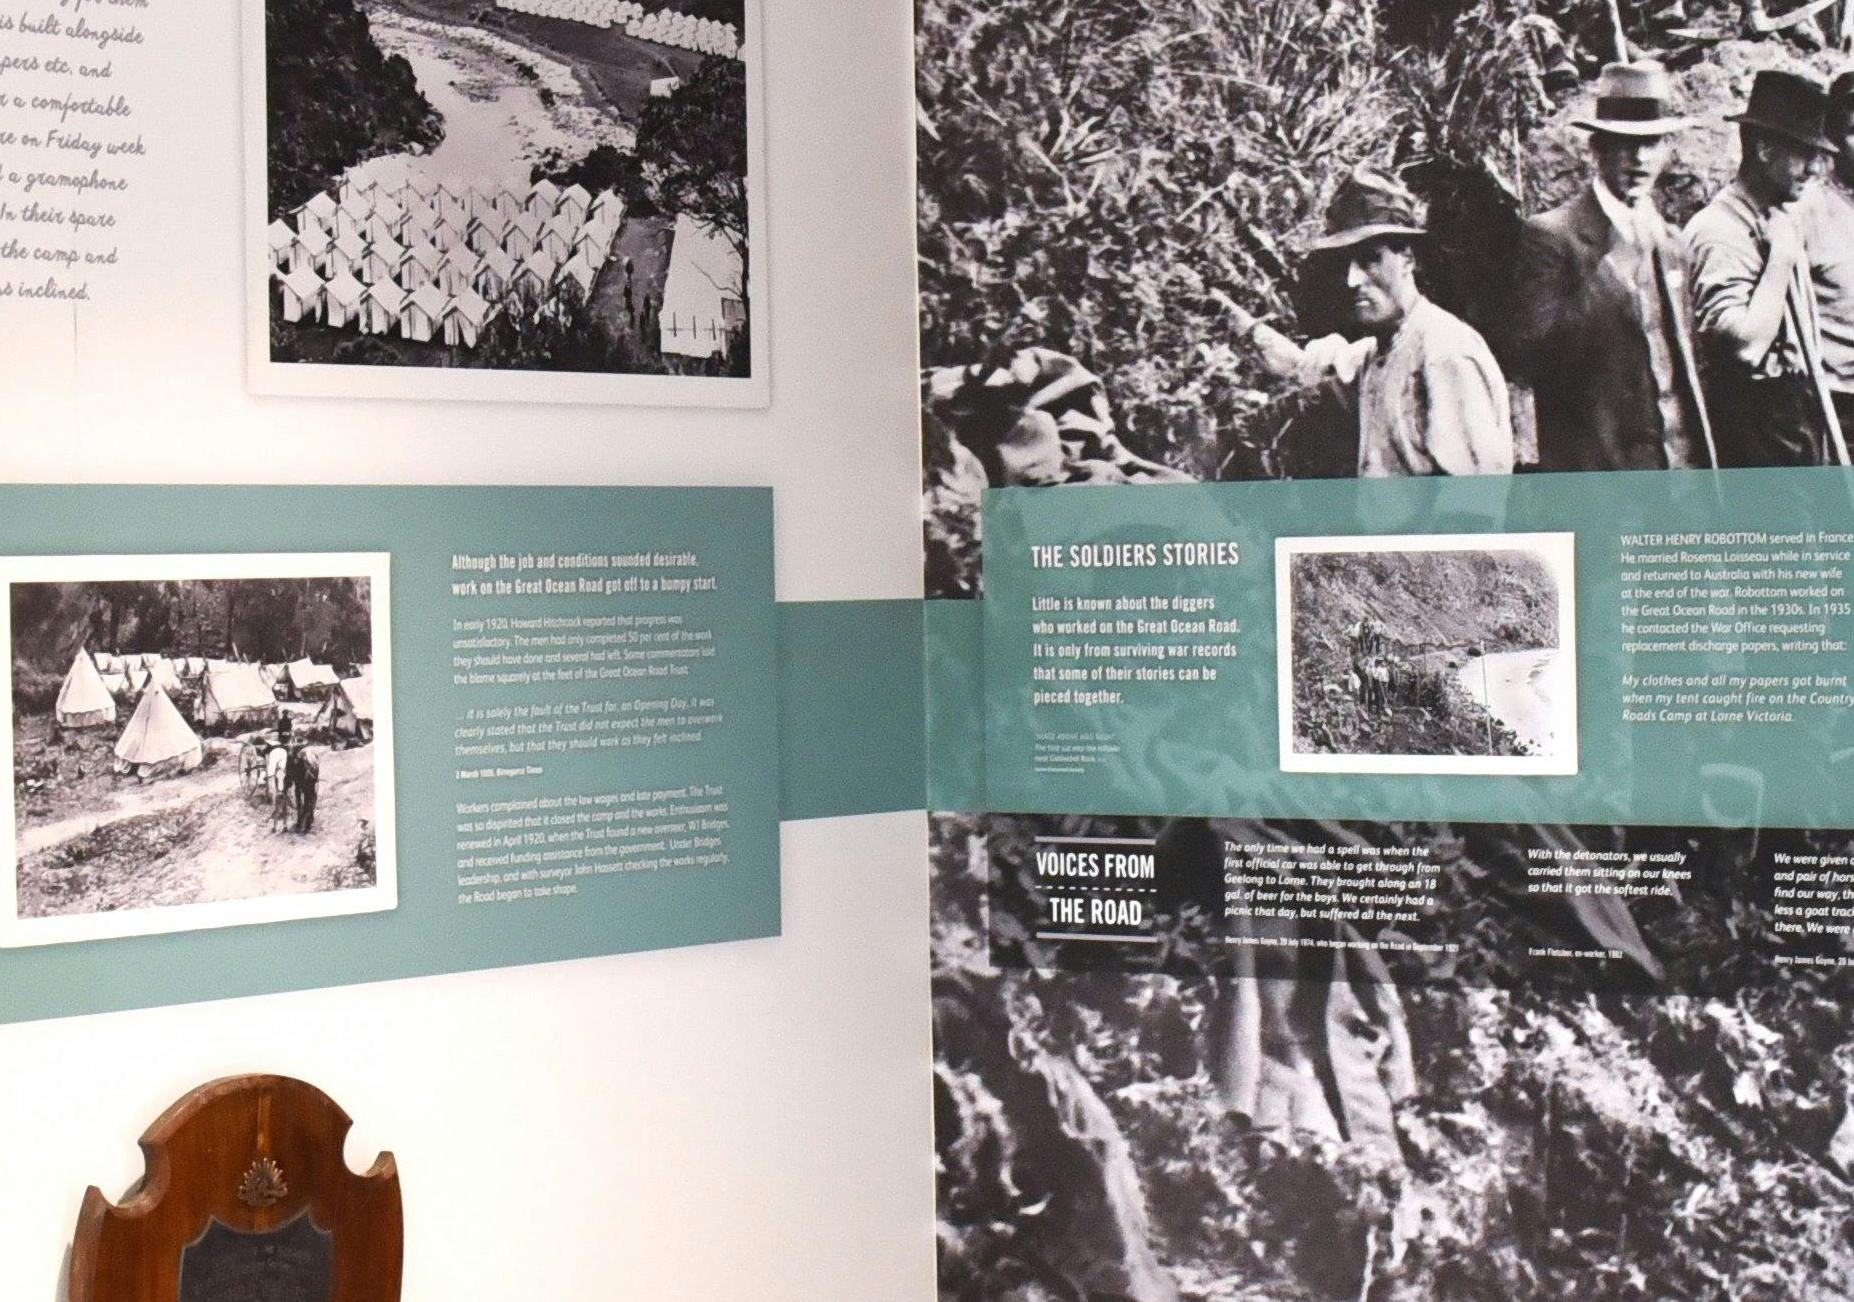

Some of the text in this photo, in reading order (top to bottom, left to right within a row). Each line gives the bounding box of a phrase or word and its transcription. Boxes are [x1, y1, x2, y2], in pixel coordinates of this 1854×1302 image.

[1621, 534, 1663, 546] WALTER
[1665, 533, 1701, 545] HENRY
[1704, 532, 1767, 545] ROBOTTOM
[1769, 532, 1804, 544] served
[1805, 532, 1816, 543] in
[1031, 542, 1239, 568] THE SOLDIERS STORIES
[1032, 596, 1215, 613] Little is known about the diggers
[1036, 851, 1155, 879] VOICES FROM
[1527, 848, 1687, 865] With the detonators, we usually
[1049, 896, 1142, 926] THE ROAD
